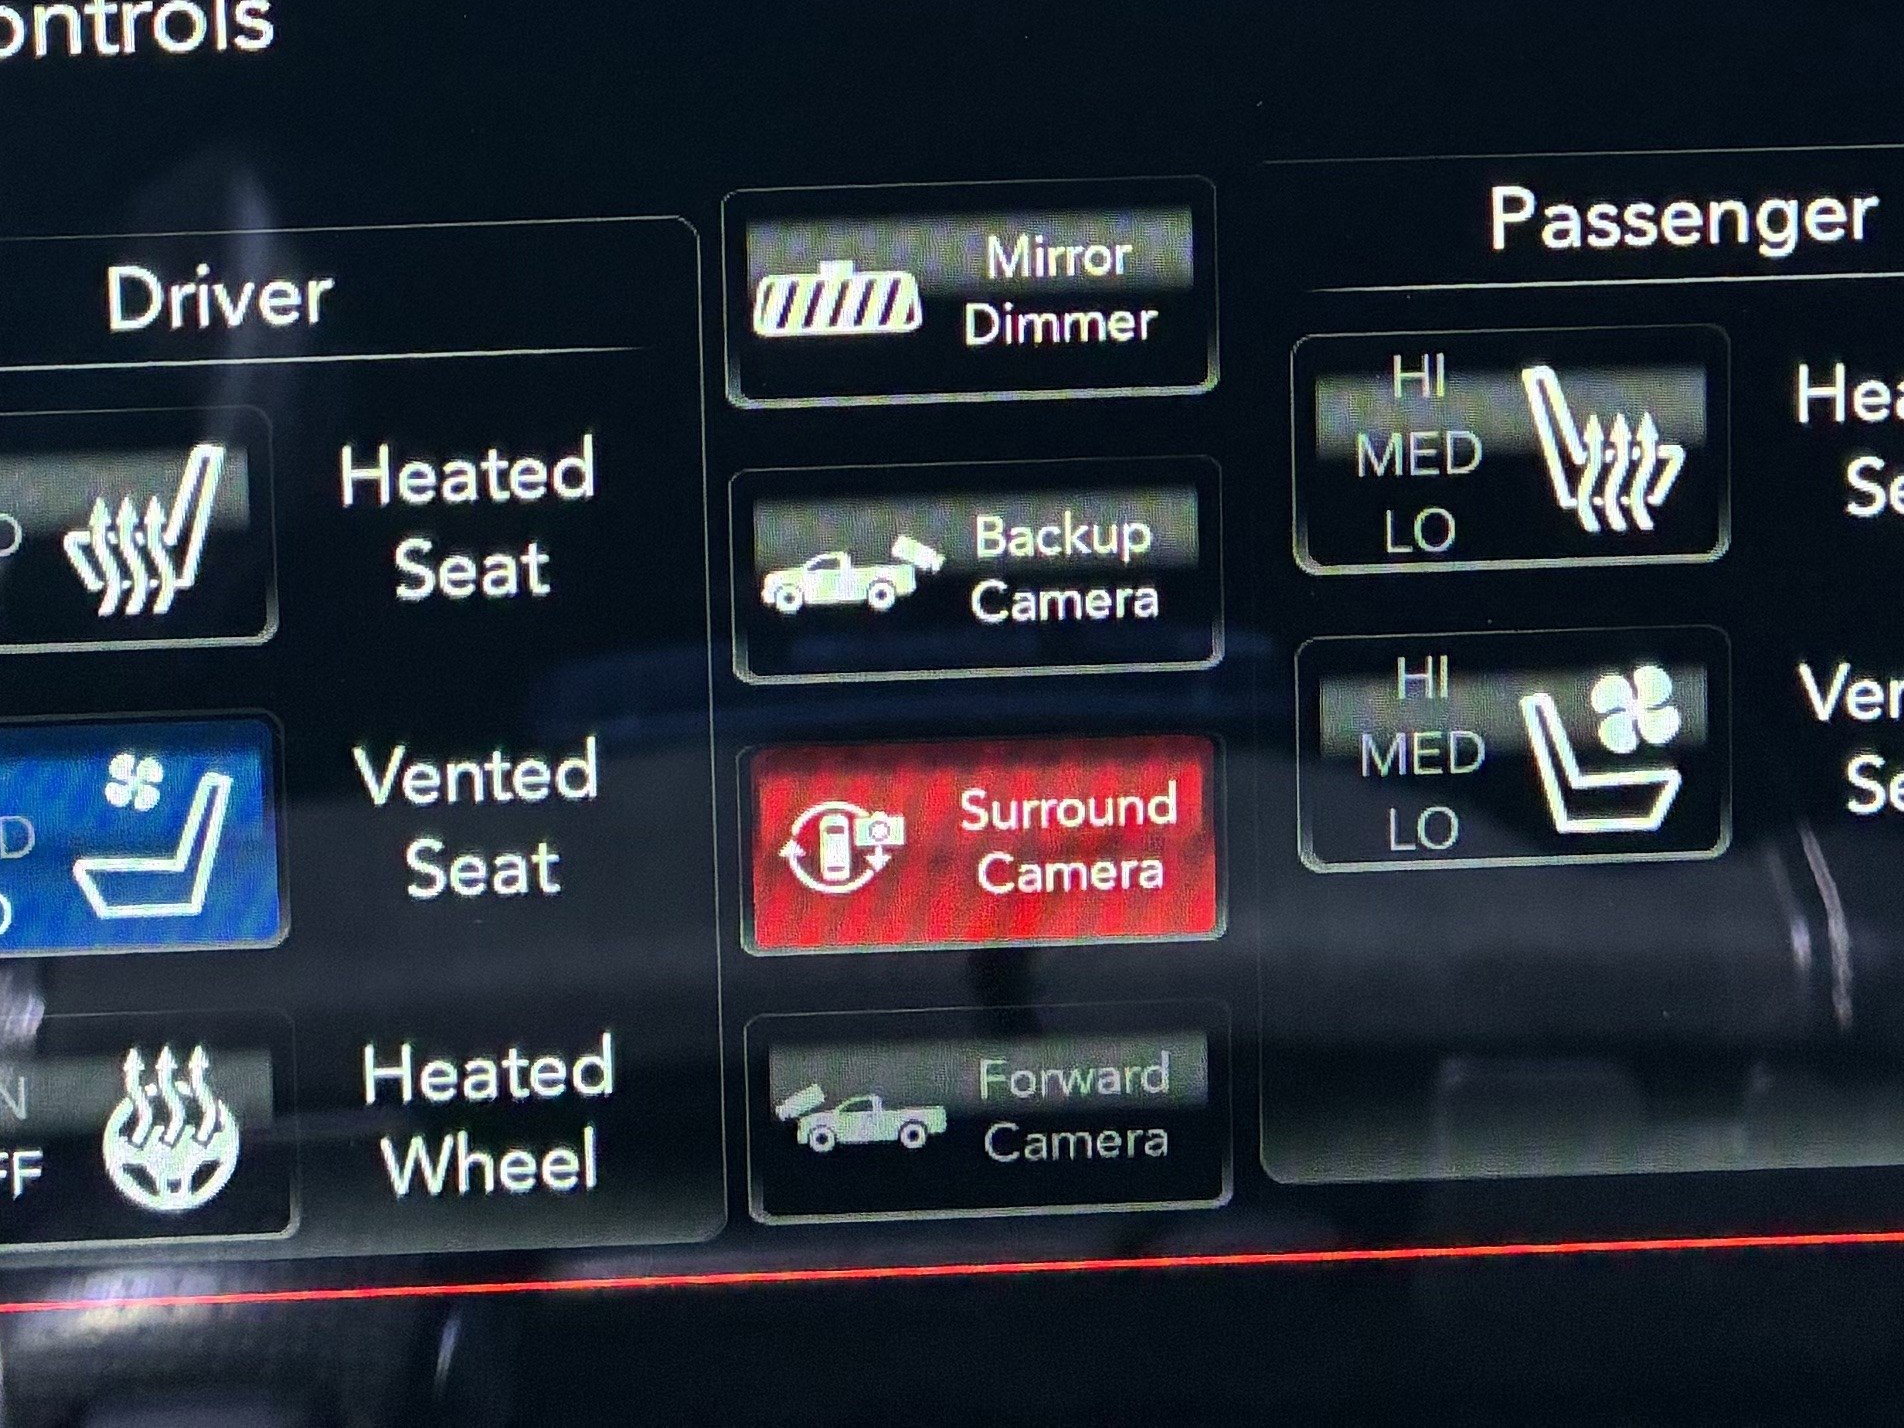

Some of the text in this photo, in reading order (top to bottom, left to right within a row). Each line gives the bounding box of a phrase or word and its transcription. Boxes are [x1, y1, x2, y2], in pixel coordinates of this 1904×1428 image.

[1492, 186, 1879, 257] Passenger
[988, 233, 1133, 279] Mirror
[108, 263, 335, 332] Driver
[966, 302, 1158, 345] Dimmer
[1394, 353, 1444, 397] HI
[342, 434, 593, 508] Heated
[1358, 431, 1482, 477] MED
[977, 510, 1153, 565] Backup
[1386, 506, 1455, 553] LO
[395, 538, 550, 601] Seat
[971, 579, 1159, 624] Camera
[1398, 655, 1448, 699] HI
[352, 734, 597, 806] Vented
[1362, 730, 1485, 777] MED
[961, 779, 1177, 830] Surround
[1390, 806, 1458, 850] LO
[406, 835, 561, 899] Seat
[978, 851, 1163, 895] Camera
[365, 1032, 613, 1105] Heated
[980, 1050, 1169, 1099] Forward
[380, 1126, 596, 1198] Wheel
[985, 1121, 1167, 1162] Camera
